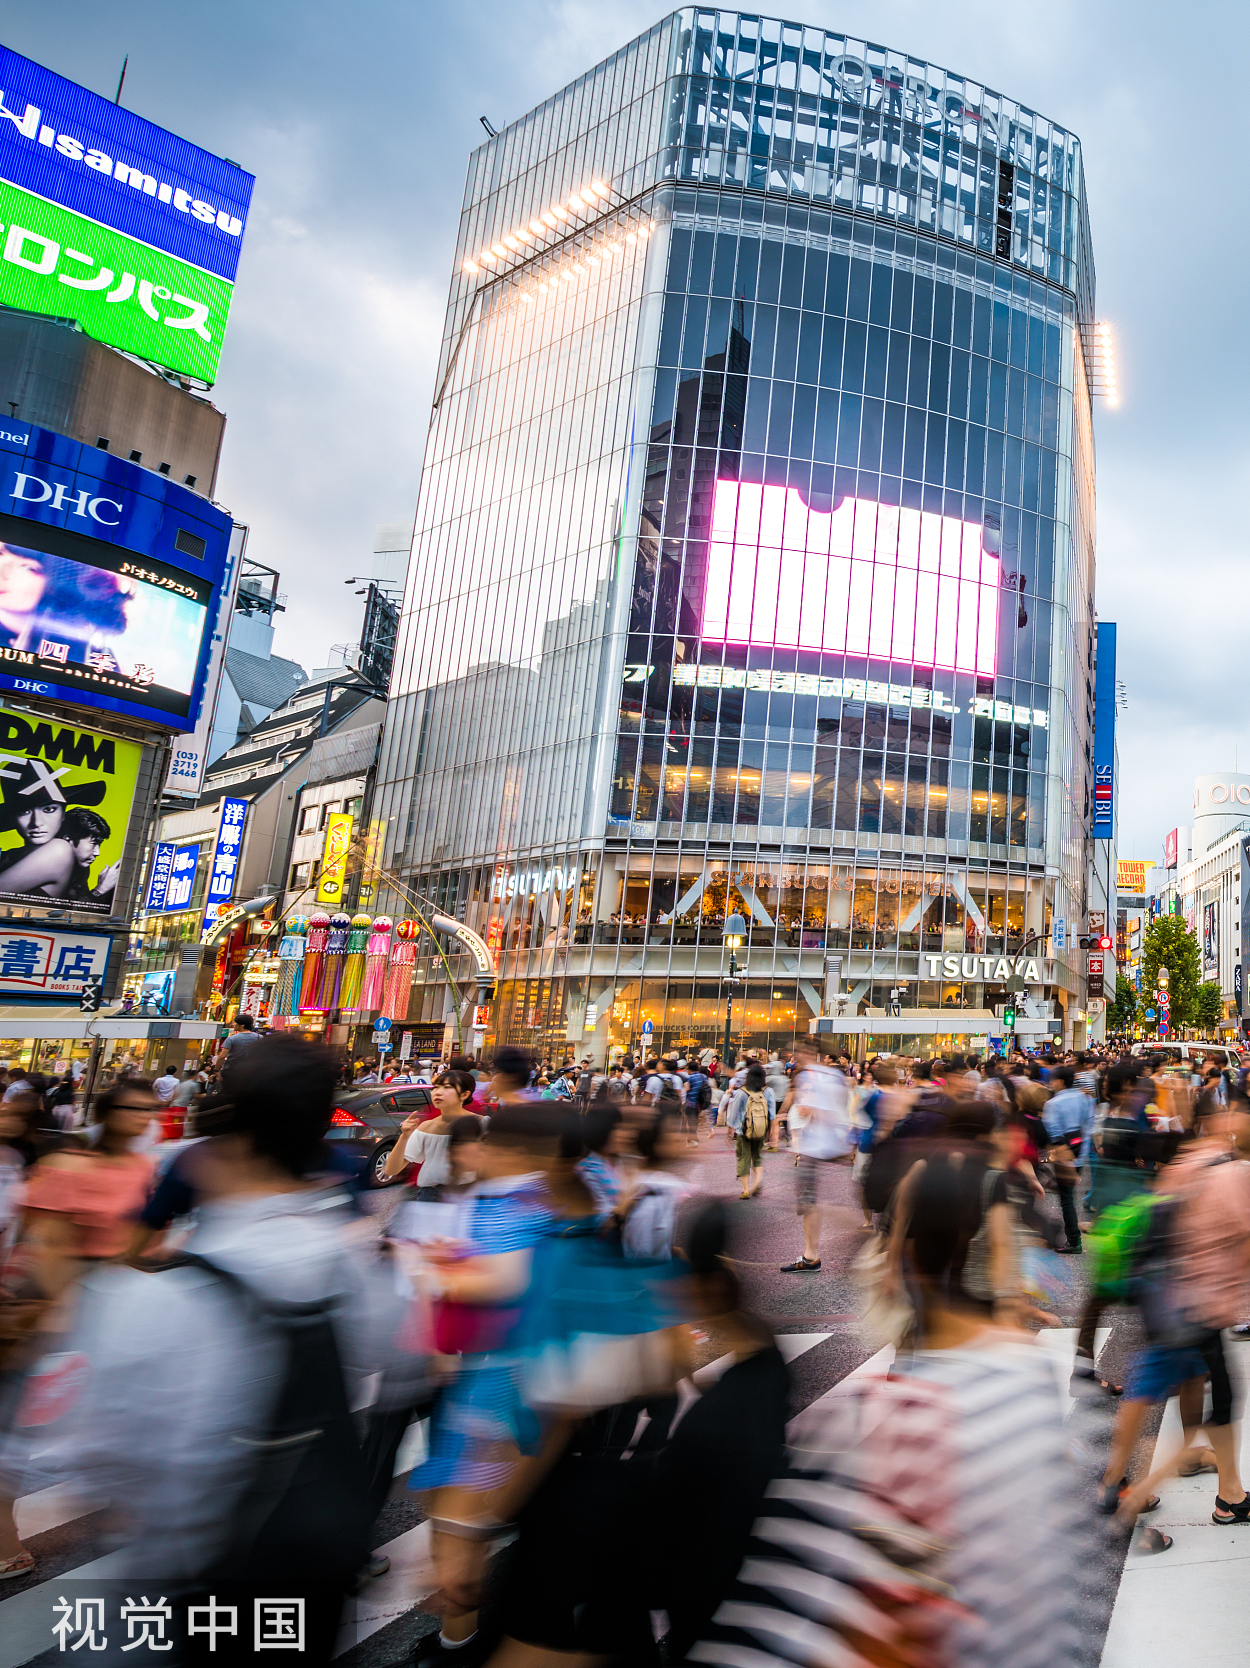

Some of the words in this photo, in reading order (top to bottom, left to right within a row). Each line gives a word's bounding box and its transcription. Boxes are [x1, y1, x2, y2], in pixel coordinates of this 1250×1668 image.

[0, 223, 211, 343] ロンパス
[9, 471, 123, 526] DHC
[13, 678, 48, 694] DHC
[0, 711, 116, 776] DMM
[176, 750, 198, 762] (03)
[170, 768, 197, 778] 2468
[172, 760, 198, 770] 3719
[1094, 764, 1112, 825] SEIBU
[210, 803, 244, 895] 洋服の青山
[1118, 862, 1145, 874] TOWER
[323, 882, 339, 893] 4F
[709, 870, 857, 891] STARBUCKS
[871, 877, 953, 897] COFFEE
[0, 939, 97, 982] 書店
[925, 955, 1040, 981] TSUTAYA
[1091, 961, 1102, 971] 本
[50, 983, 71, 991] BOOKS
[242, 988, 256, 1016] ラーメ
